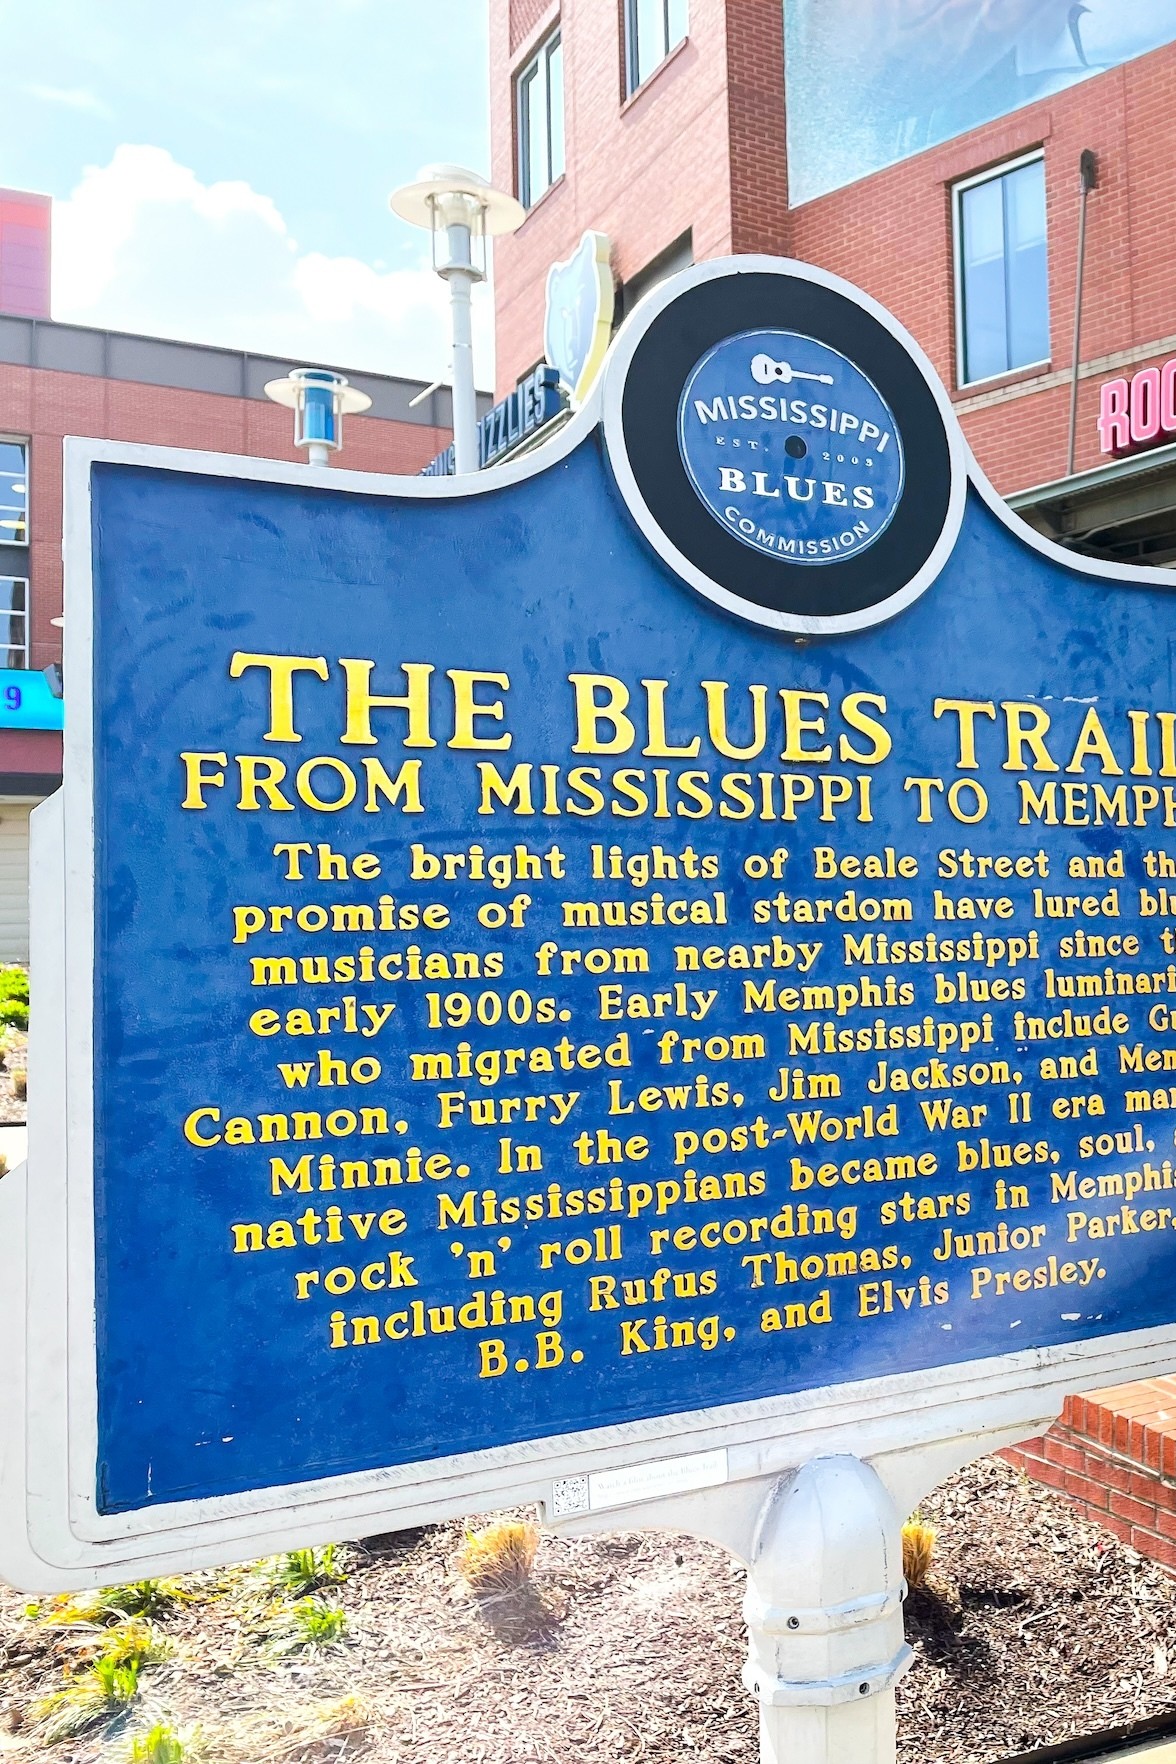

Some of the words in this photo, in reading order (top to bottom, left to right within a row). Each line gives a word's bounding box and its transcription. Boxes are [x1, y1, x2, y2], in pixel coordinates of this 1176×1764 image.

[694, 395, 890, 453] MISSISSIPPI
[716, 436, 769, 452] EST.
[718, 467, 875, 509] BLUES
[724, 506, 871, 555] COMMISSION
[230, 651, 512, 750] THE
[569, 674, 892, 764] BLUES
[181, 753, 423, 812] FROM
[477, 762, 873, 822] MISSISSIPPI
[905, 778, 988, 823] TO
[274, 844, 380, 879] The
[412, 845, 564, 888] bright
[592, 845, 718, 887] lights
[745, 849, 787, 878] of
[815, 848, 917, 878] Beale
[939, 850, 1048, 877] Street
[1069, 851, 1124, 877] and
[234, 896, 449, 943] promise
[478, 895, 530, 928] of
[563, 893, 726, 926] musical
[755, 892, 912, 923] stardom
[935, 891, 1012, 919] have
[1034, 890, 1119, 917] lured
[251, 946, 502, 985] musicians
[536, 943, 648, 975] from
[675, 936, 822, 971] nearby
[845, 932, 1038, 967] Mississippi
[1060, 931, 1138, 957] since
[250, 997, 394, 1036] early
[427, 990, 570, 1028] 1900s.
[599, 983, 716, 1020] Early
[744, 976, 913, 1015] Memphis
[936, 973, 1024, 1003] blues
[280, 1050, 380, 1087] who
[411, 1033, 630, 1085] migrated
[659, 1031, 764, 1064] from
[790, 1014, 992, 1055] Mississippi
[1015, 1007, 1128, 1040] include
[184, 1108, 407, 1147] Cannon,
[439, 1092, 578, 1128] Furry
[609, 1075, 743, 1114] Lewis,
[769, 1068, 840, 1101] Jim
[869, 1059, 1022, 1092] Jackson,
[1041, 1049, 1097, 1079] and
[271, 1148, 469, 1195] Minnie.
[499, 1139, 542, 1173] In
[574, 1130, 648, 1165] the
[674, 1105, 899, 1165] post-World
[921, 1099, 986, 1129] War
[1009, 1093, 1030, 1123] II
[1053, 1095, 1104, 1119] era
[232, 1207, 406, 1252] native
[437, 1169, 766, 1231] Mississippians
[791, 1154, 936, 1190] became
[958, 1139, 1059, 1171] blues,
[1080, 1125, 1153, 1157] soul,
[296, 1252, 417, 1299] rock
[451, 1237, 510, 1278] 'n'
[540, 1225, 621, 1268] roll
[650, 1203, 858, 1256] recording
[882, 1193, 970, 1224] stars
[996, 1180, 1028, 1210] in
[330, 1290, 564, 1350] including
[590, 1269, 716, 1311] Rufus
[742, 1246, 911, 1287] Thomas,
[934, 1223, 1045, 1260] Junior
[480, 1331, 583, 1377] B.B.
[621, 1316, 735, 1355] King,
[761, 1290, 831, 1332] and
[859, 1277, 948, 1316] Elvis
[972, 1256, 1105, 1299] Presley.
